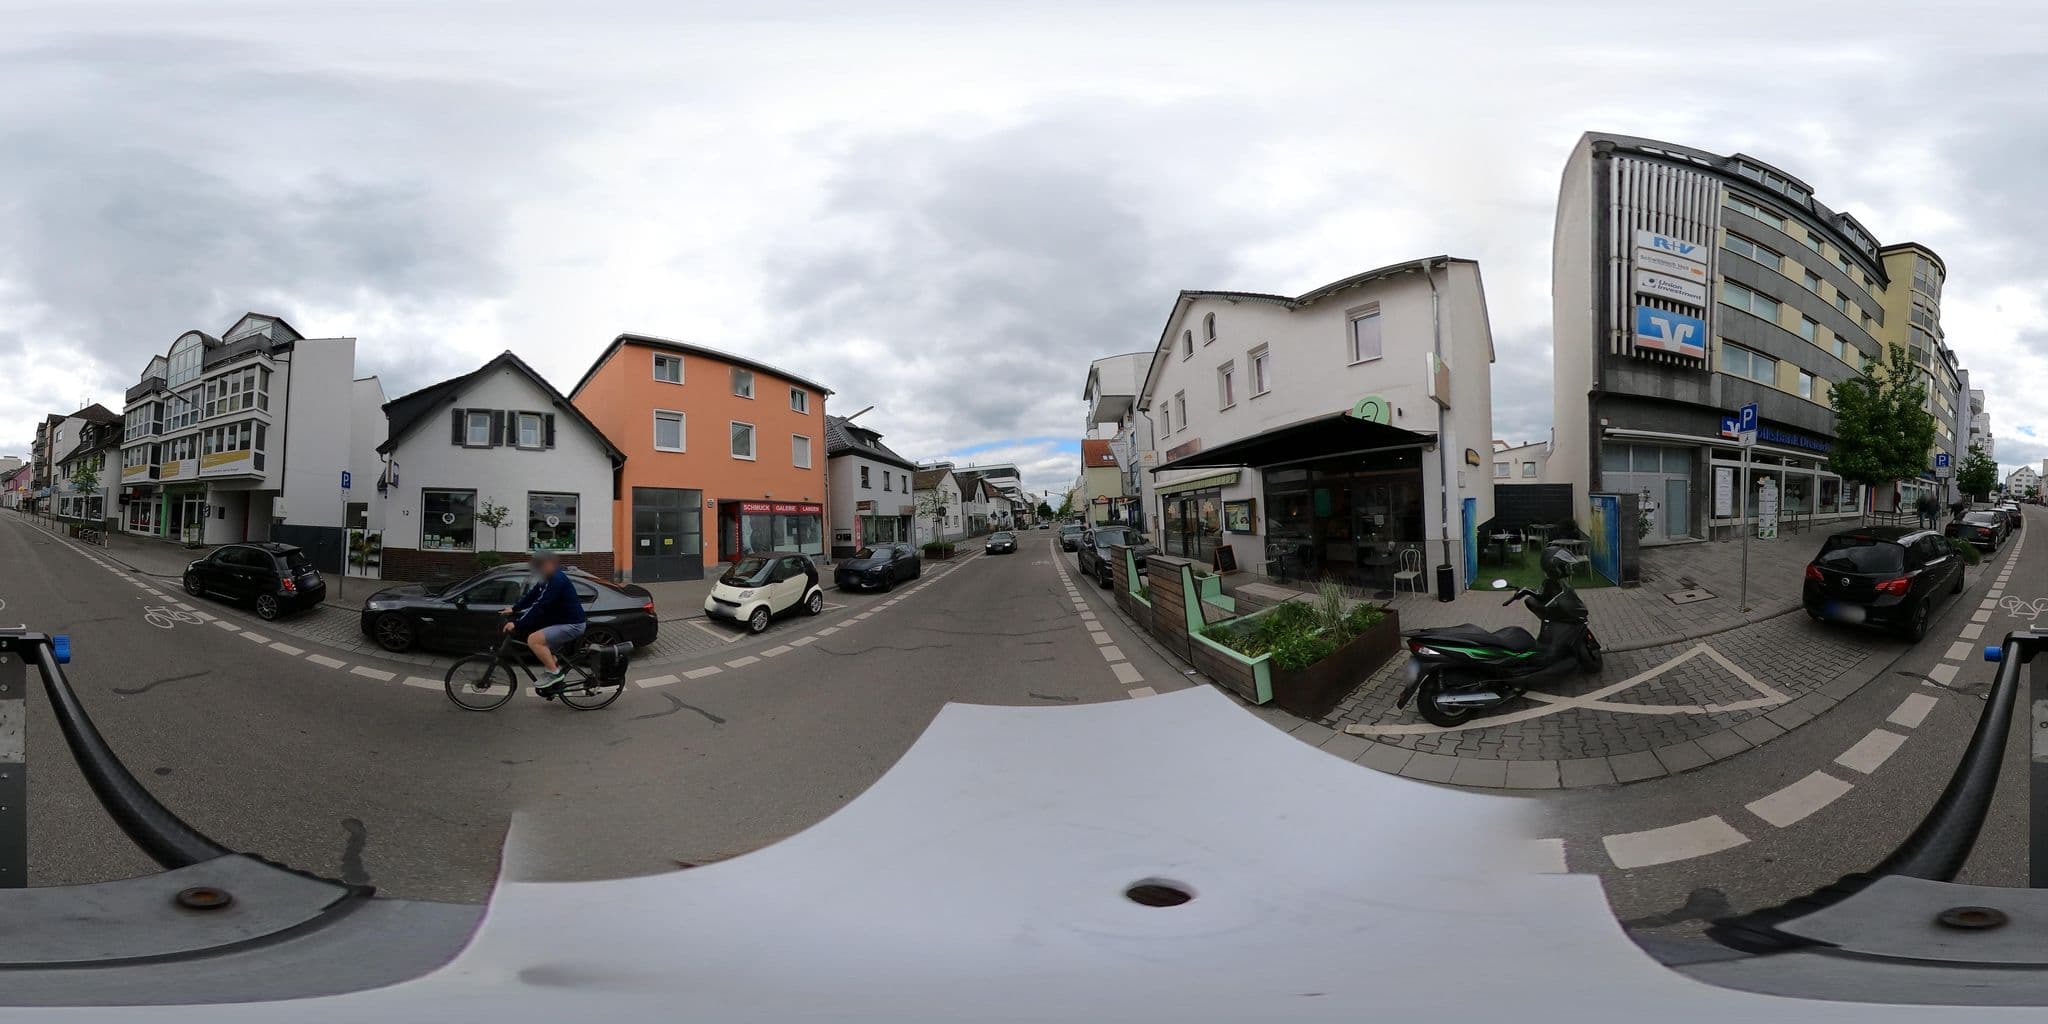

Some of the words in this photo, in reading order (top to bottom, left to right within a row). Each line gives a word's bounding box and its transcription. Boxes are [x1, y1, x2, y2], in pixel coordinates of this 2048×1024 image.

[1653, 236, 1696, 254] R+V
[1658, 279, 1683, 290] Union
[1657, 285, 1702, 300] Investment
[1743, 408, 1753, 429] P
[1757, 426, 1799, 446] olksbank
[1938, 455, 1946, 466] P
[343, 473, 350, 486] P
